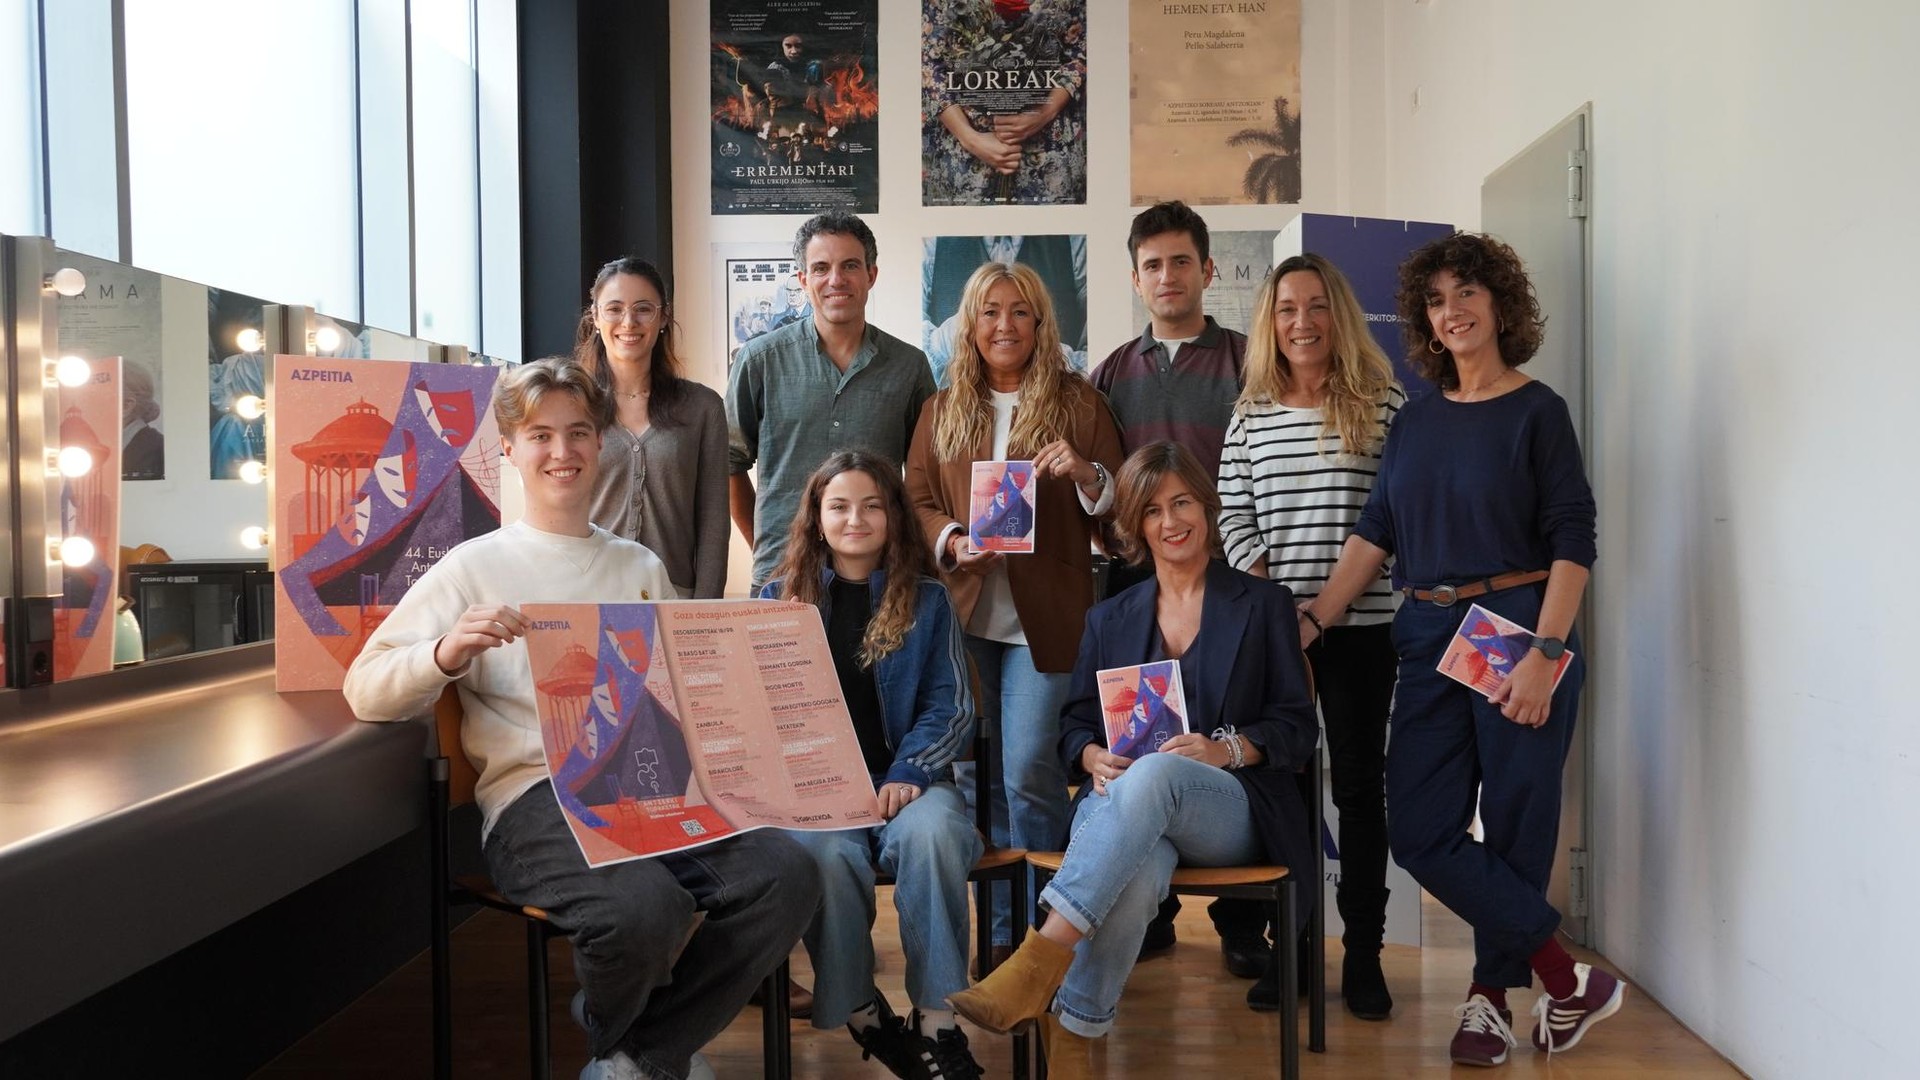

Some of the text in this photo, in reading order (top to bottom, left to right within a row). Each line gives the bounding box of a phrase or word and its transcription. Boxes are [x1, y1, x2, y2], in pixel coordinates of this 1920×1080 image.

[1163, 2, 1266, 15] HEMEN ETA HAN
[1184, 30, 1245, 40] Peru Magdalena
[1206, 41, 1244, 50] Salaberria
[946, 69, 1063, 91] LOREAK
[731, 162, 856, 177] ERREMENTARI
[290, 369, 353, 383] AZPEITIA
[404, 546, 424, 559] 44.
[673, 612, 694, 620] Goza
[695, 610, 731, 621] dezagun
[732, 607, 761, 617] euskal
[531, 620, 571, 631] AZPEITIA
[759, 663, 786, 671] DIAMANTE
